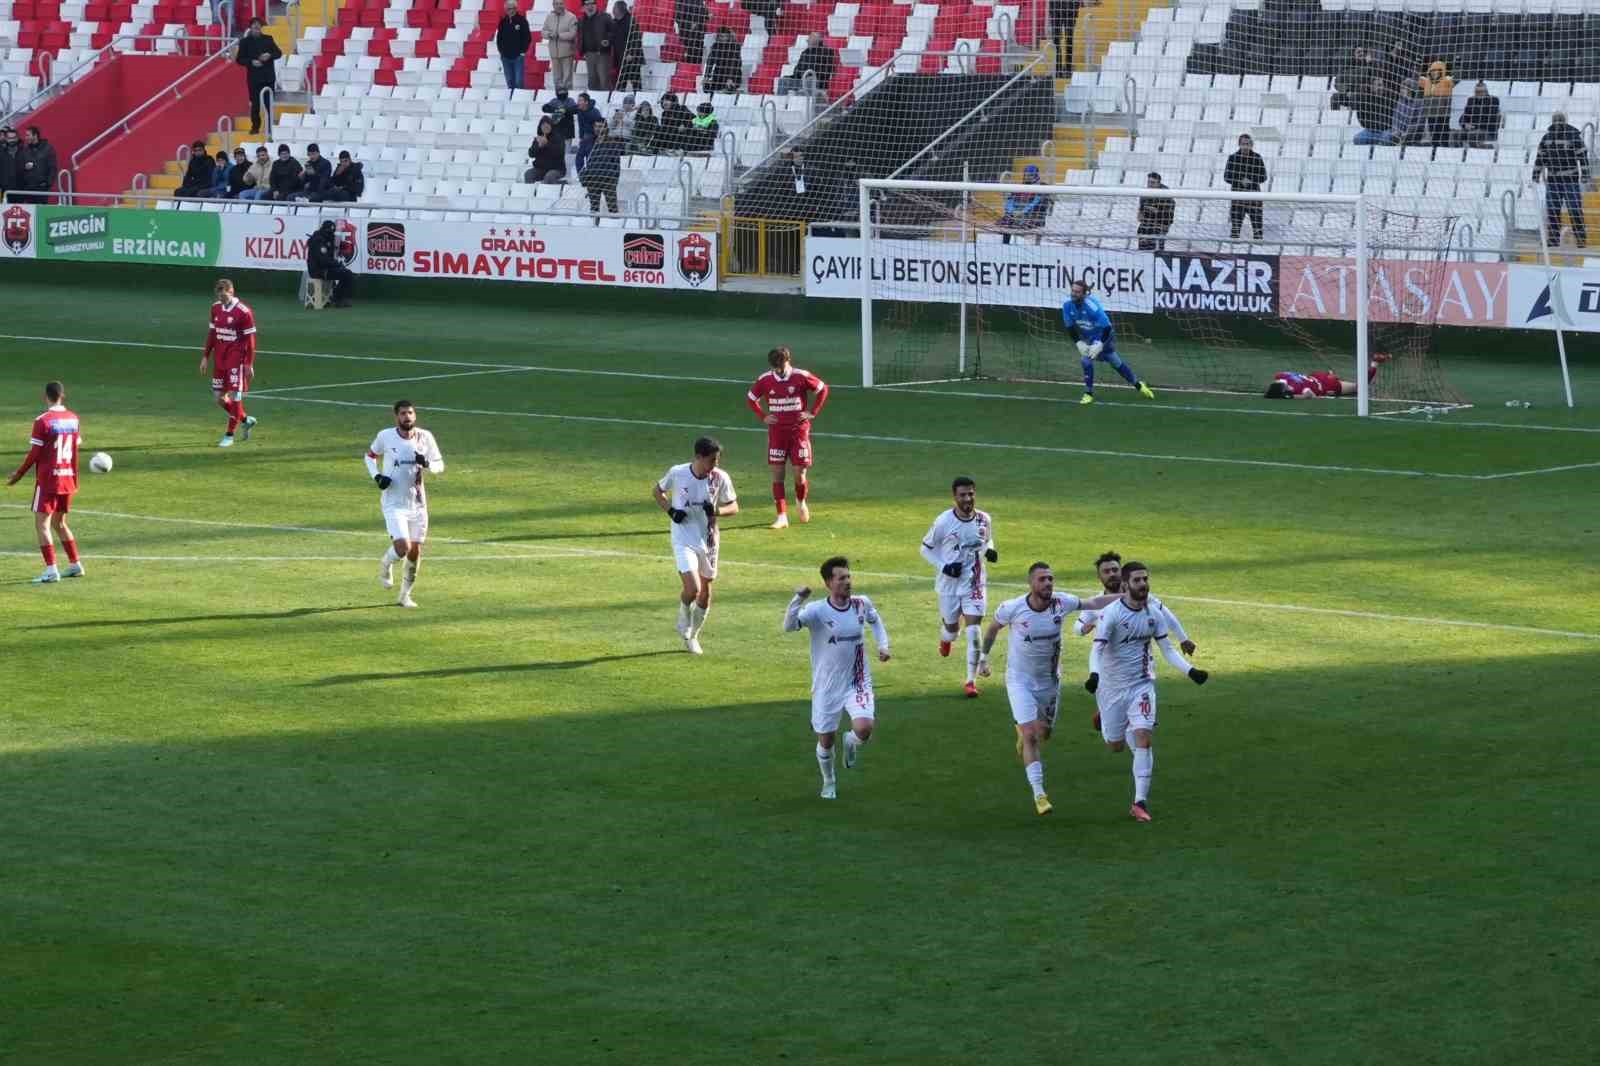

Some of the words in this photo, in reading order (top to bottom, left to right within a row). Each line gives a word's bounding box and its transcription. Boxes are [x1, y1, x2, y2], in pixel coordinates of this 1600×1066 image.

[49, 214, 106, 238] ZENGİN
[112, 233, 206, 258] ERZİNCAN
[245, 237, 309, 260] KIZILAY
[481, 237, 545, 254] GRAND
[413, 249, 511, 275] SİMAY
[516, 257, 616, 282] HOTEL
[893, 258, 960, 283] BETON
[966, 259, 1075, 289] SEYFETTİN
[1083, 261, 1145, 296] ÇİÇEK
[1154, 256, 1273, 294] NAZİR
[1154, 291, 1274, 313] KUYUMCULUK
[1288, 263, 1508, 321] ATASAY
[54, 434, 73, 464] 14
[1138, 702, 1152, 715] 10
